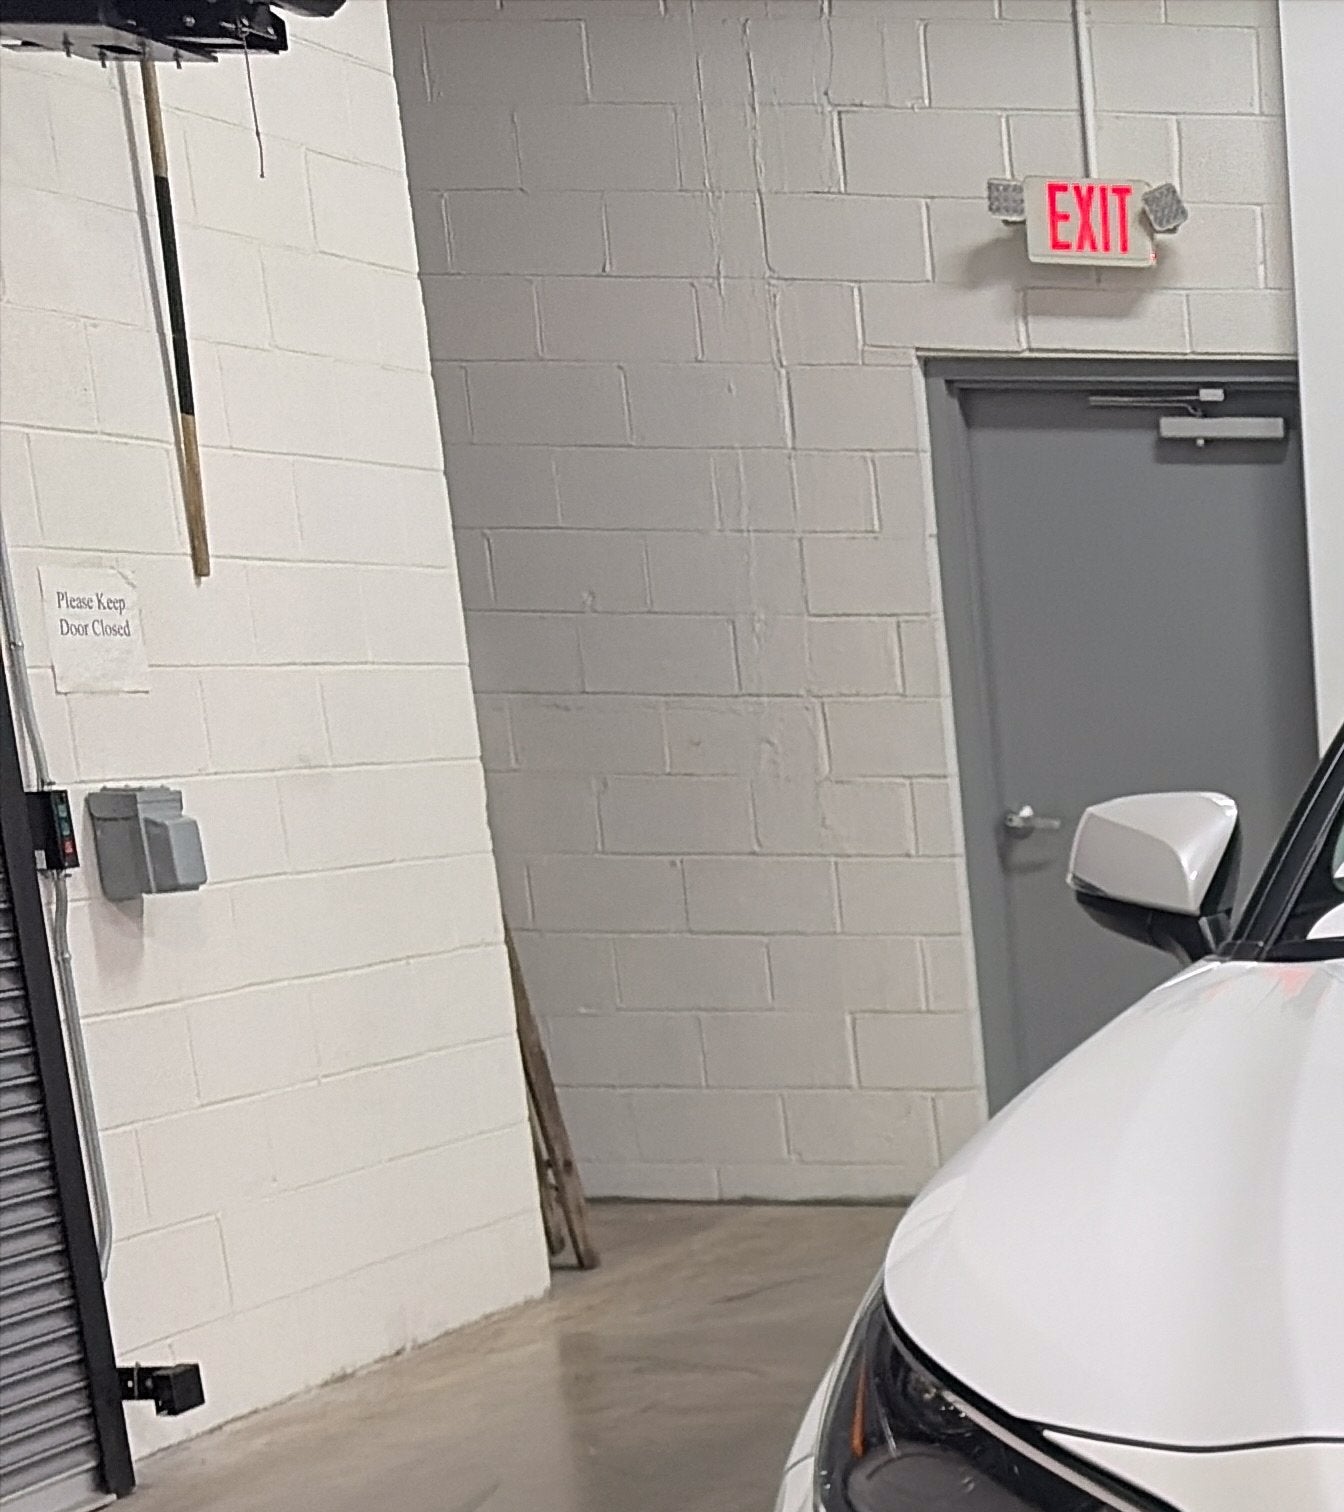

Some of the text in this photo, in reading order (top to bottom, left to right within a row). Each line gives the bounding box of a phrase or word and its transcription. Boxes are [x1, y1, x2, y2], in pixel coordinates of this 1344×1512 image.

[1046, 182, 1133, 254] EXIT
[56, 591, 126, 615] Please Keep
[59, 618, 131, 637] Door Closed
